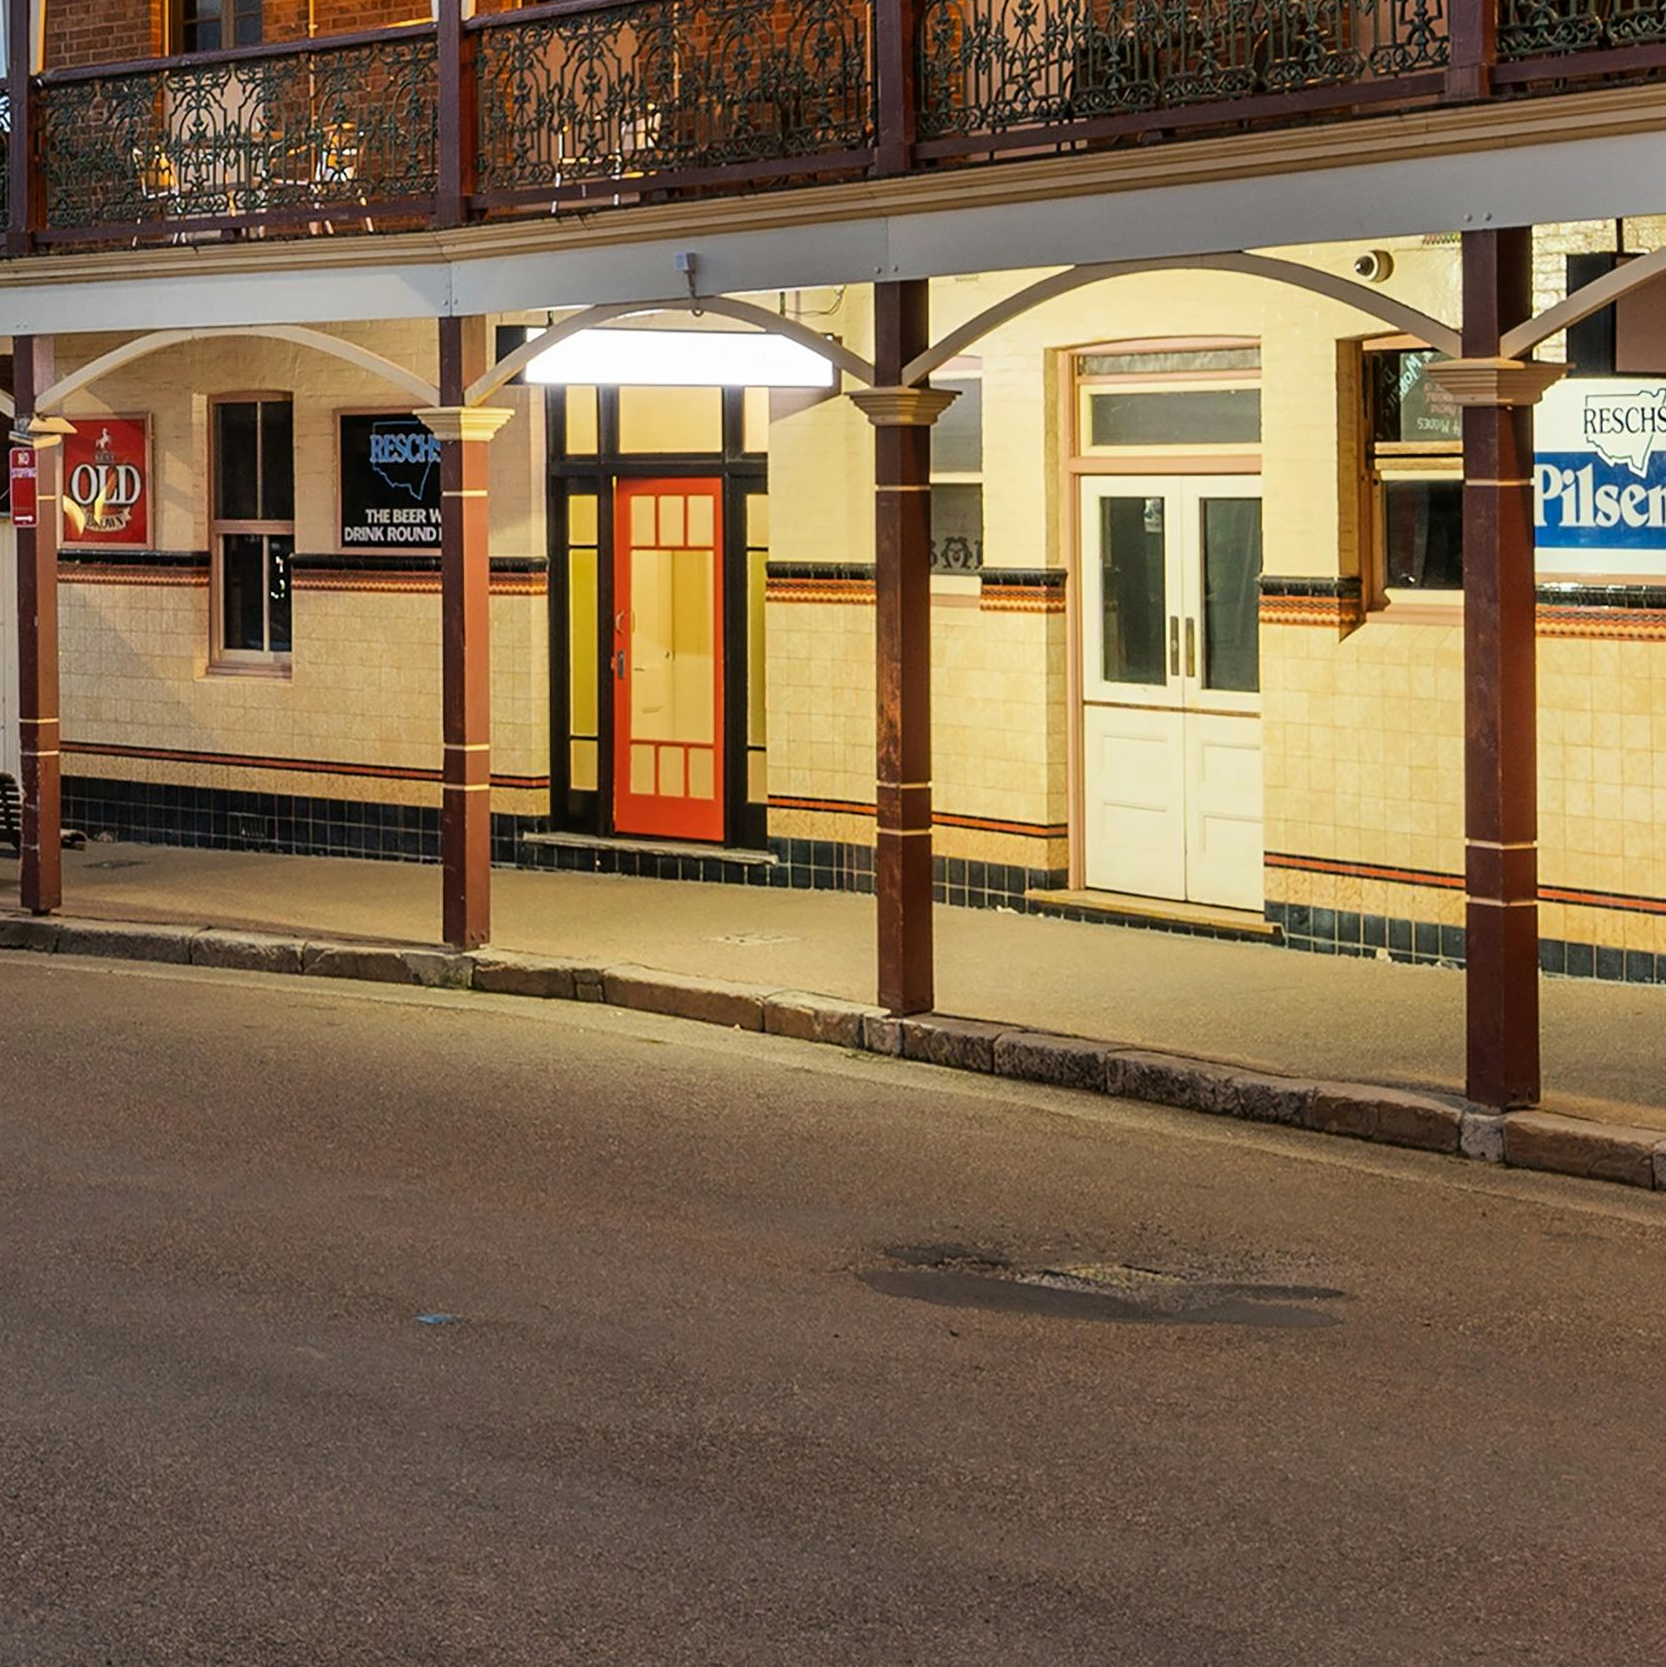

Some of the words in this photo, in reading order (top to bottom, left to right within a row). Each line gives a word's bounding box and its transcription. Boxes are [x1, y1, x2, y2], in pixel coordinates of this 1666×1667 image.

[71, 463, 142, 506] OLD
[365, 508, 390, 524] THE
[393, 508, 426, 524] BEER
[344, 526, 384, 542] DRINK
[387, 526, 437, 542] ROUND
